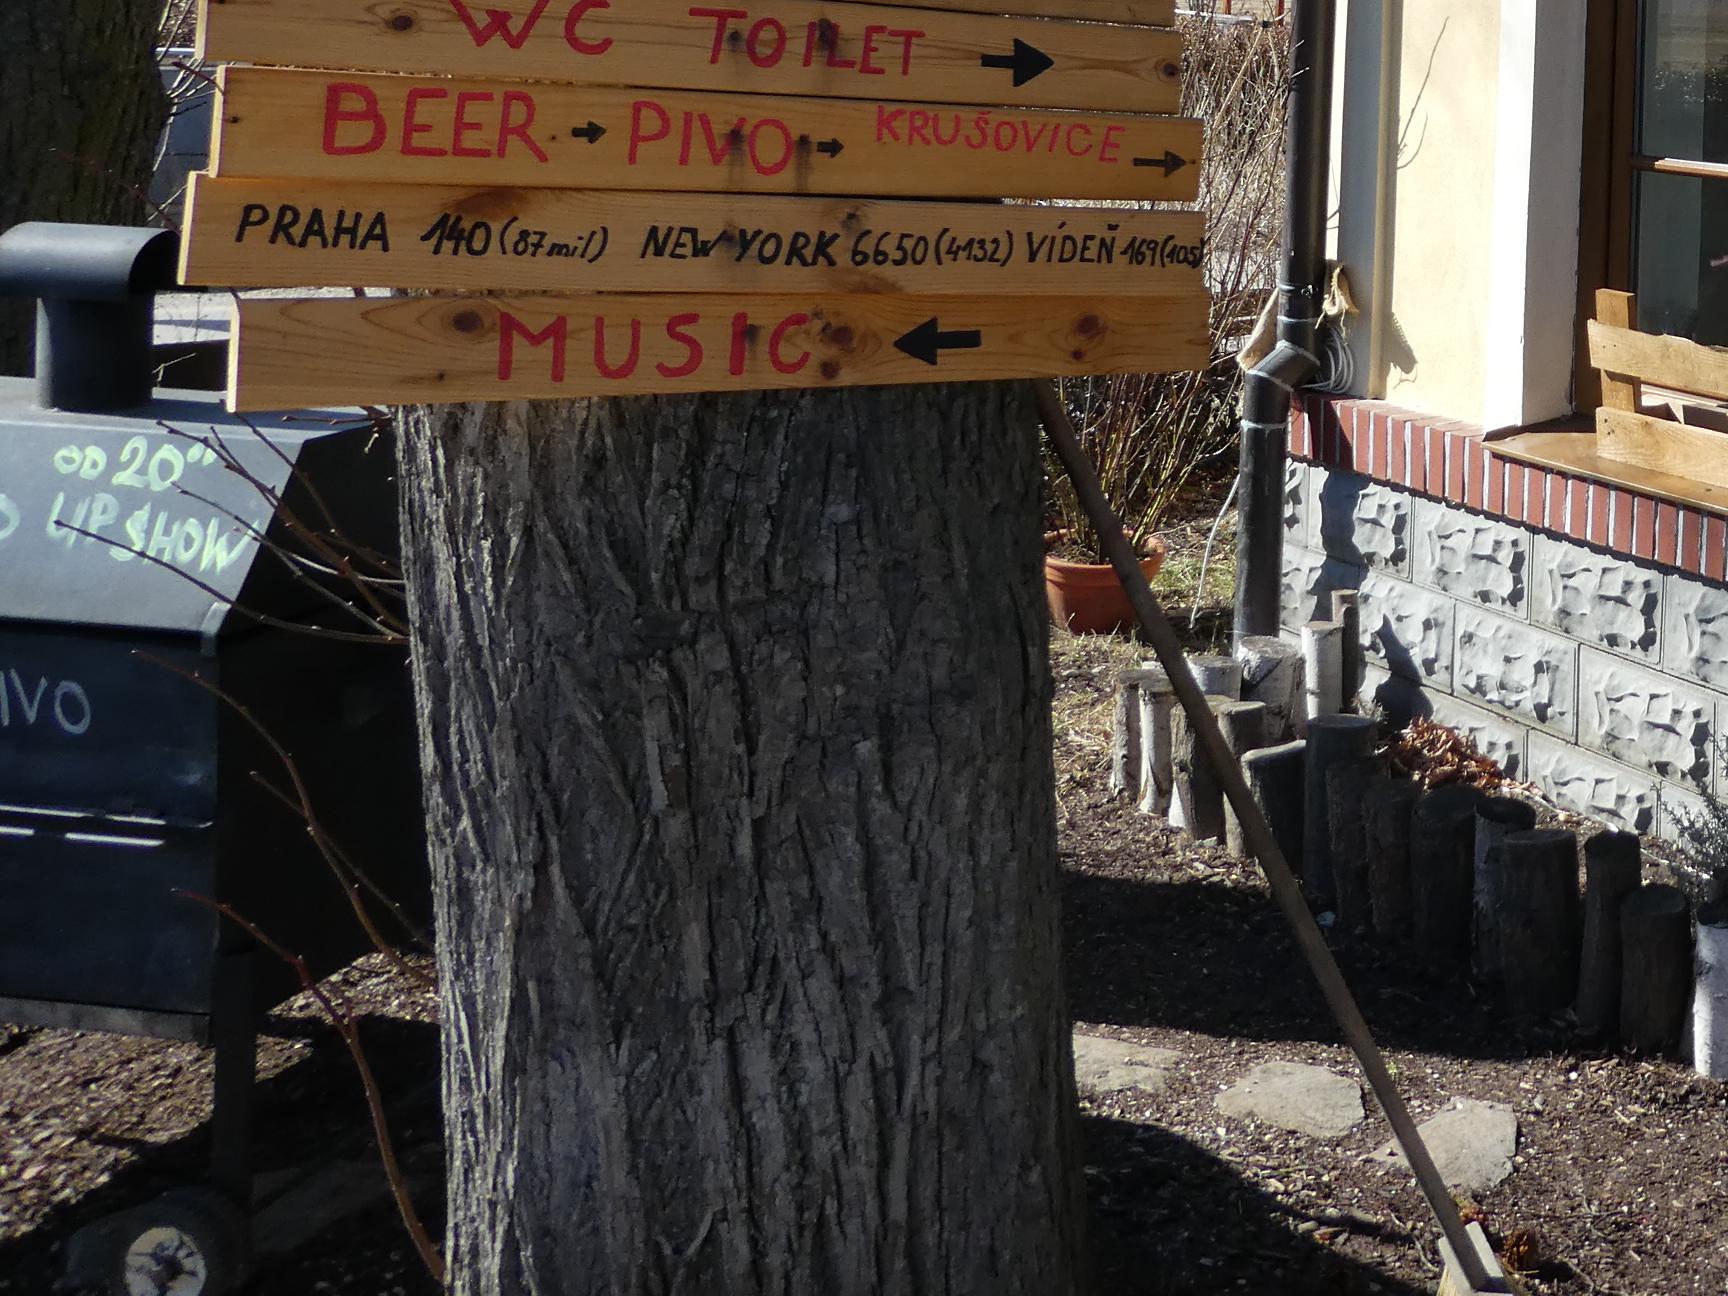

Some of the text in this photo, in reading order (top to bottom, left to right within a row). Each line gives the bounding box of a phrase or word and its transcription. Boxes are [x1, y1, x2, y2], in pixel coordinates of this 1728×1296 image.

[689, 7, 926, 76] TOILET
[322, 82, 1127, 176] BEER PIVO KRUŠOVICE
[235, 204, 390, 253] PRAHA
[639, 225, 729, 260] NEW
[735, 227, 841, 267] YORK
[1026, 221, 1120, 264] VÍDEŇ
[499, 311, 811, 383] MUSIC
[54, 445, 107, 480] OD
[109, 501, 260, 576] SHOW
